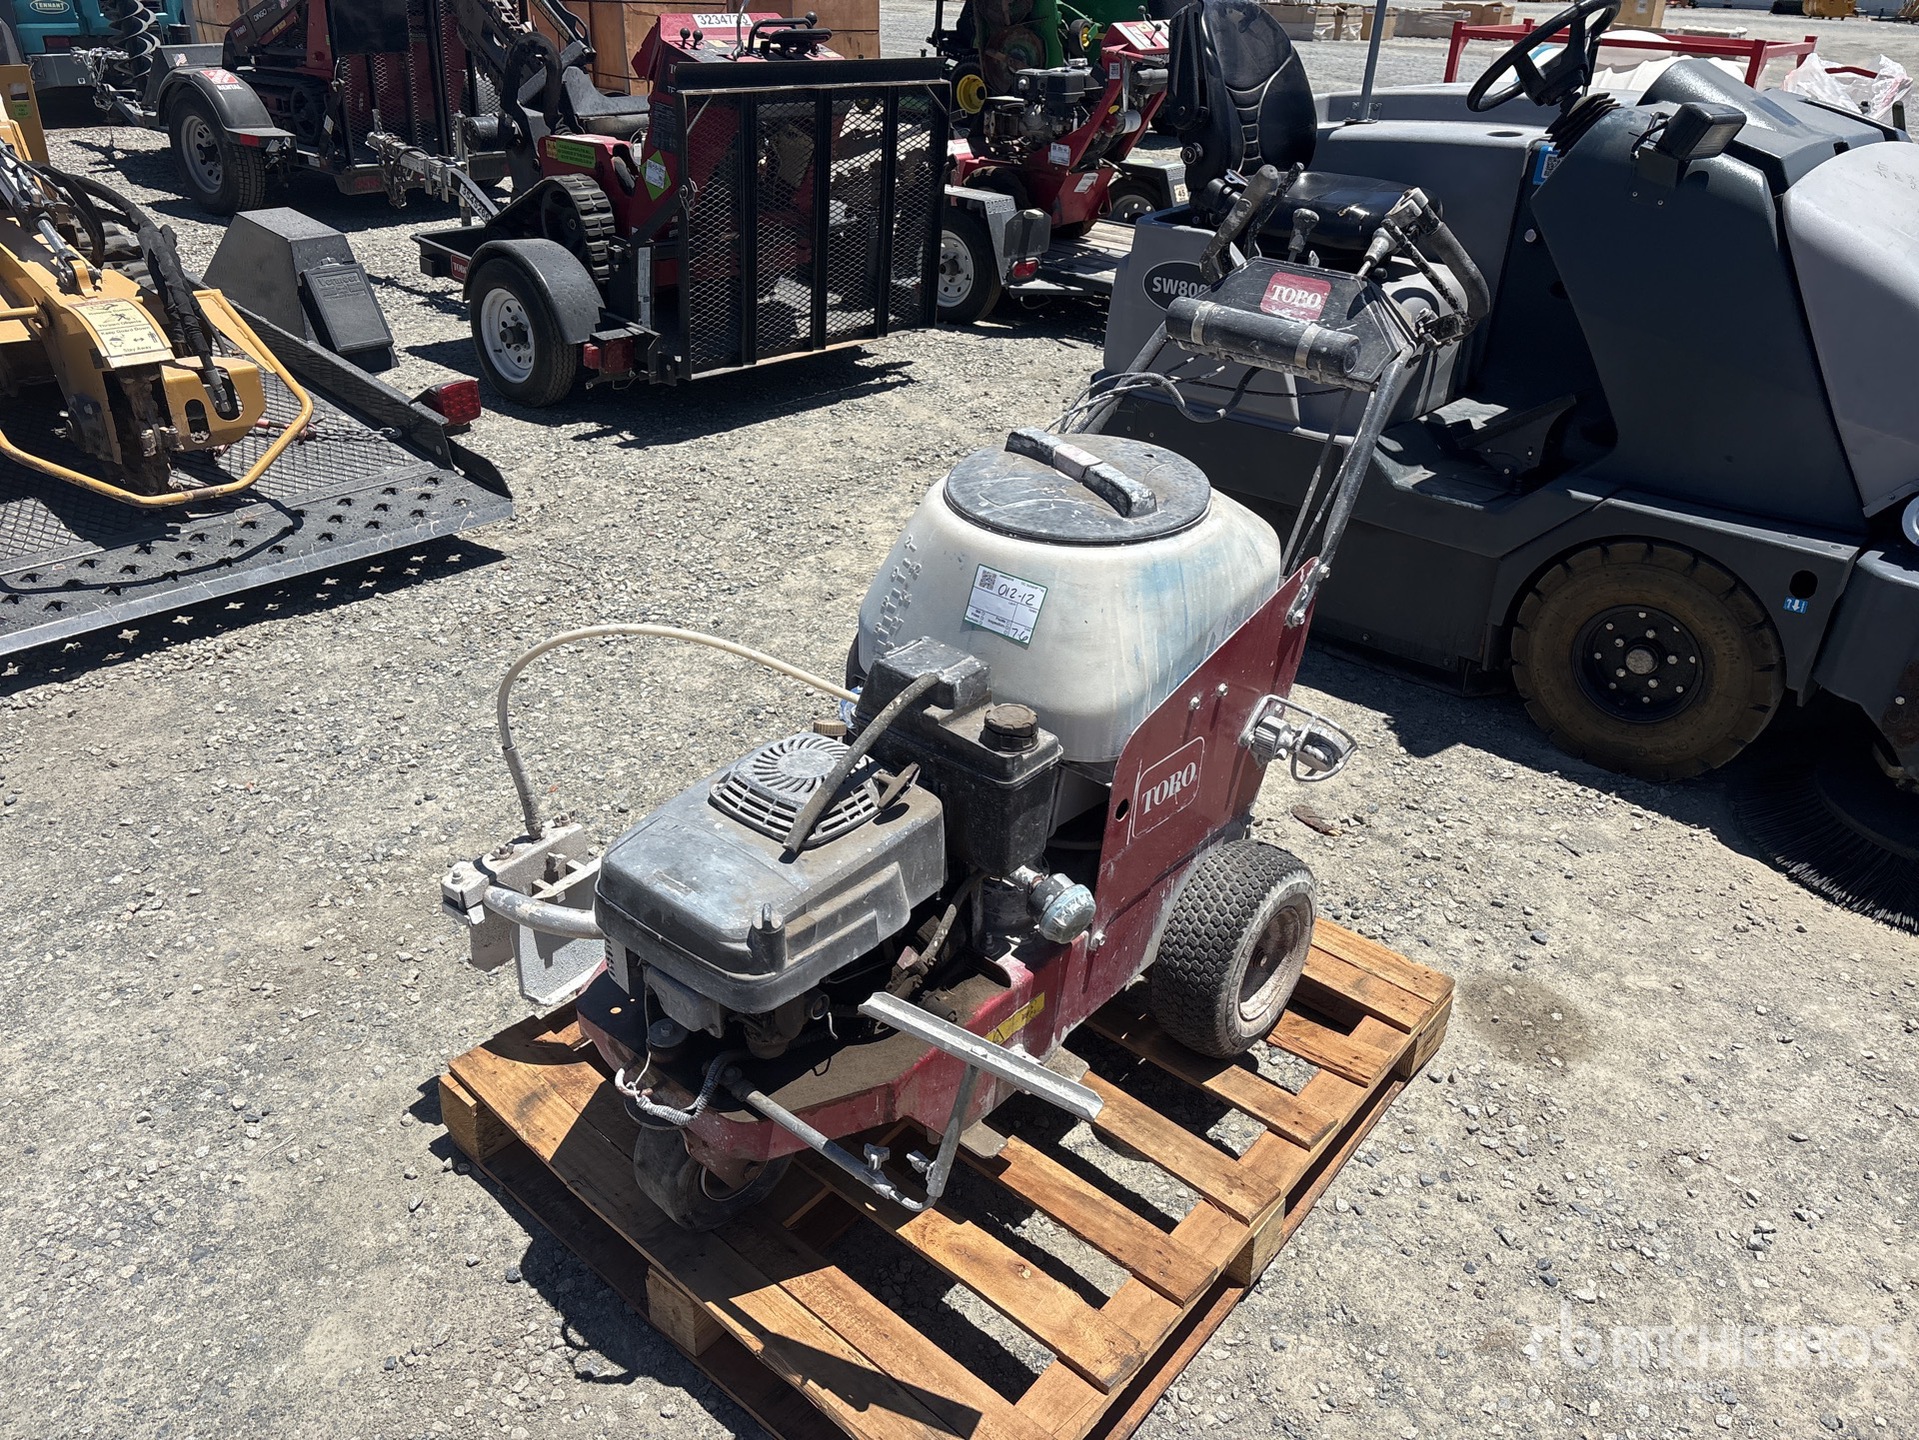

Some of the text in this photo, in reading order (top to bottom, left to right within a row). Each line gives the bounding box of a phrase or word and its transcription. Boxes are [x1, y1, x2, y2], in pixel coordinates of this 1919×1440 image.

[234, 24, 247, 38] TORO
[1270, 284, 1322, 309] TORO
[997, 583, 1035, 606] 012-12
[1141, 761, 1197, 816] TORO
